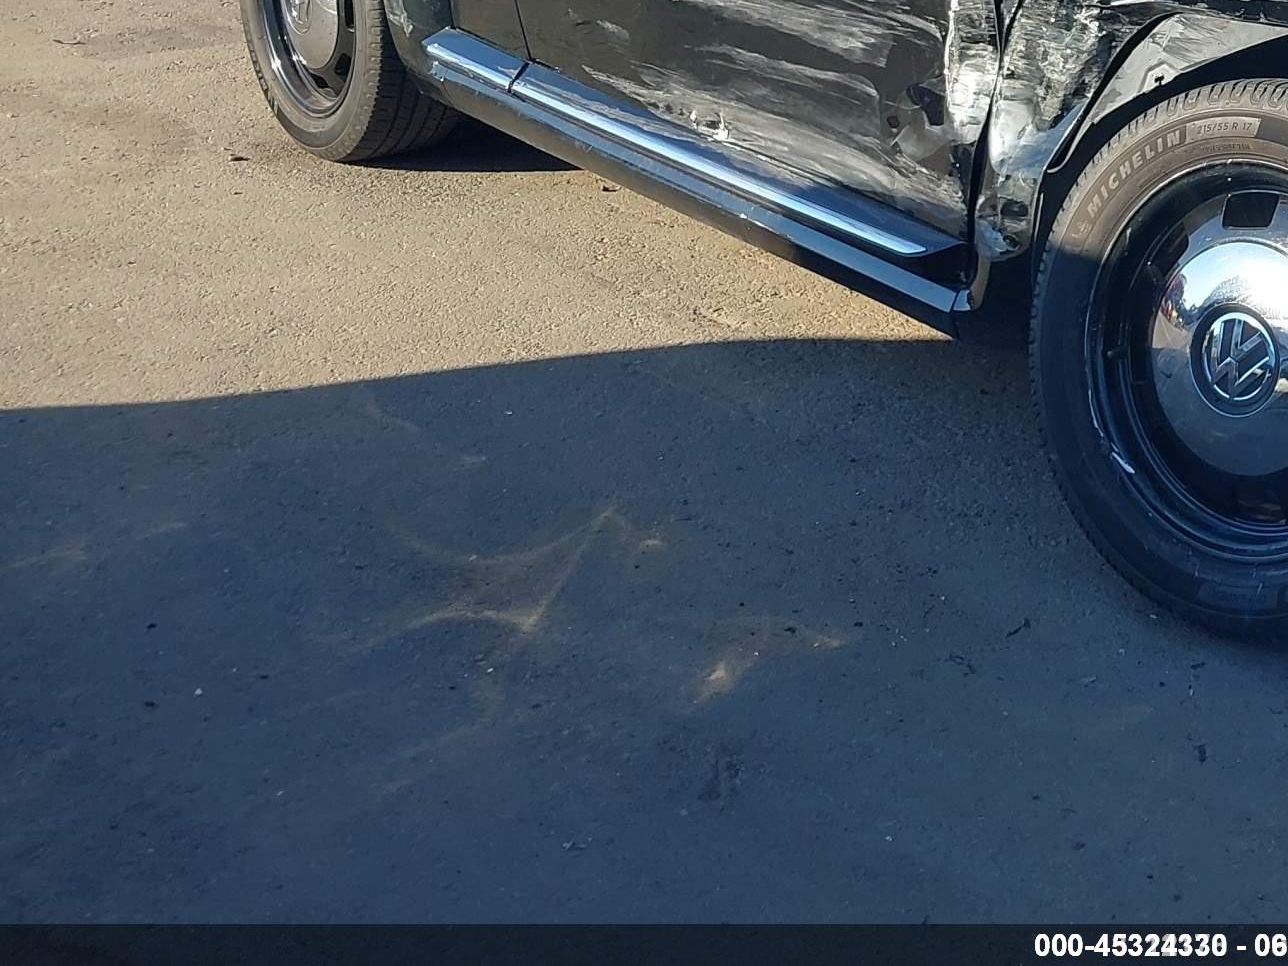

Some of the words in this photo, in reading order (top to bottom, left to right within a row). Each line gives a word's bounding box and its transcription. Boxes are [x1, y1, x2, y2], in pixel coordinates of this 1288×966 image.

[1197, 122, 1229, 134] 215/55
[1231, 122, 1239, 131] R
[1242, 122, 1252, 131] 17
[1087, 129, 1181, 218] MICHELIN
